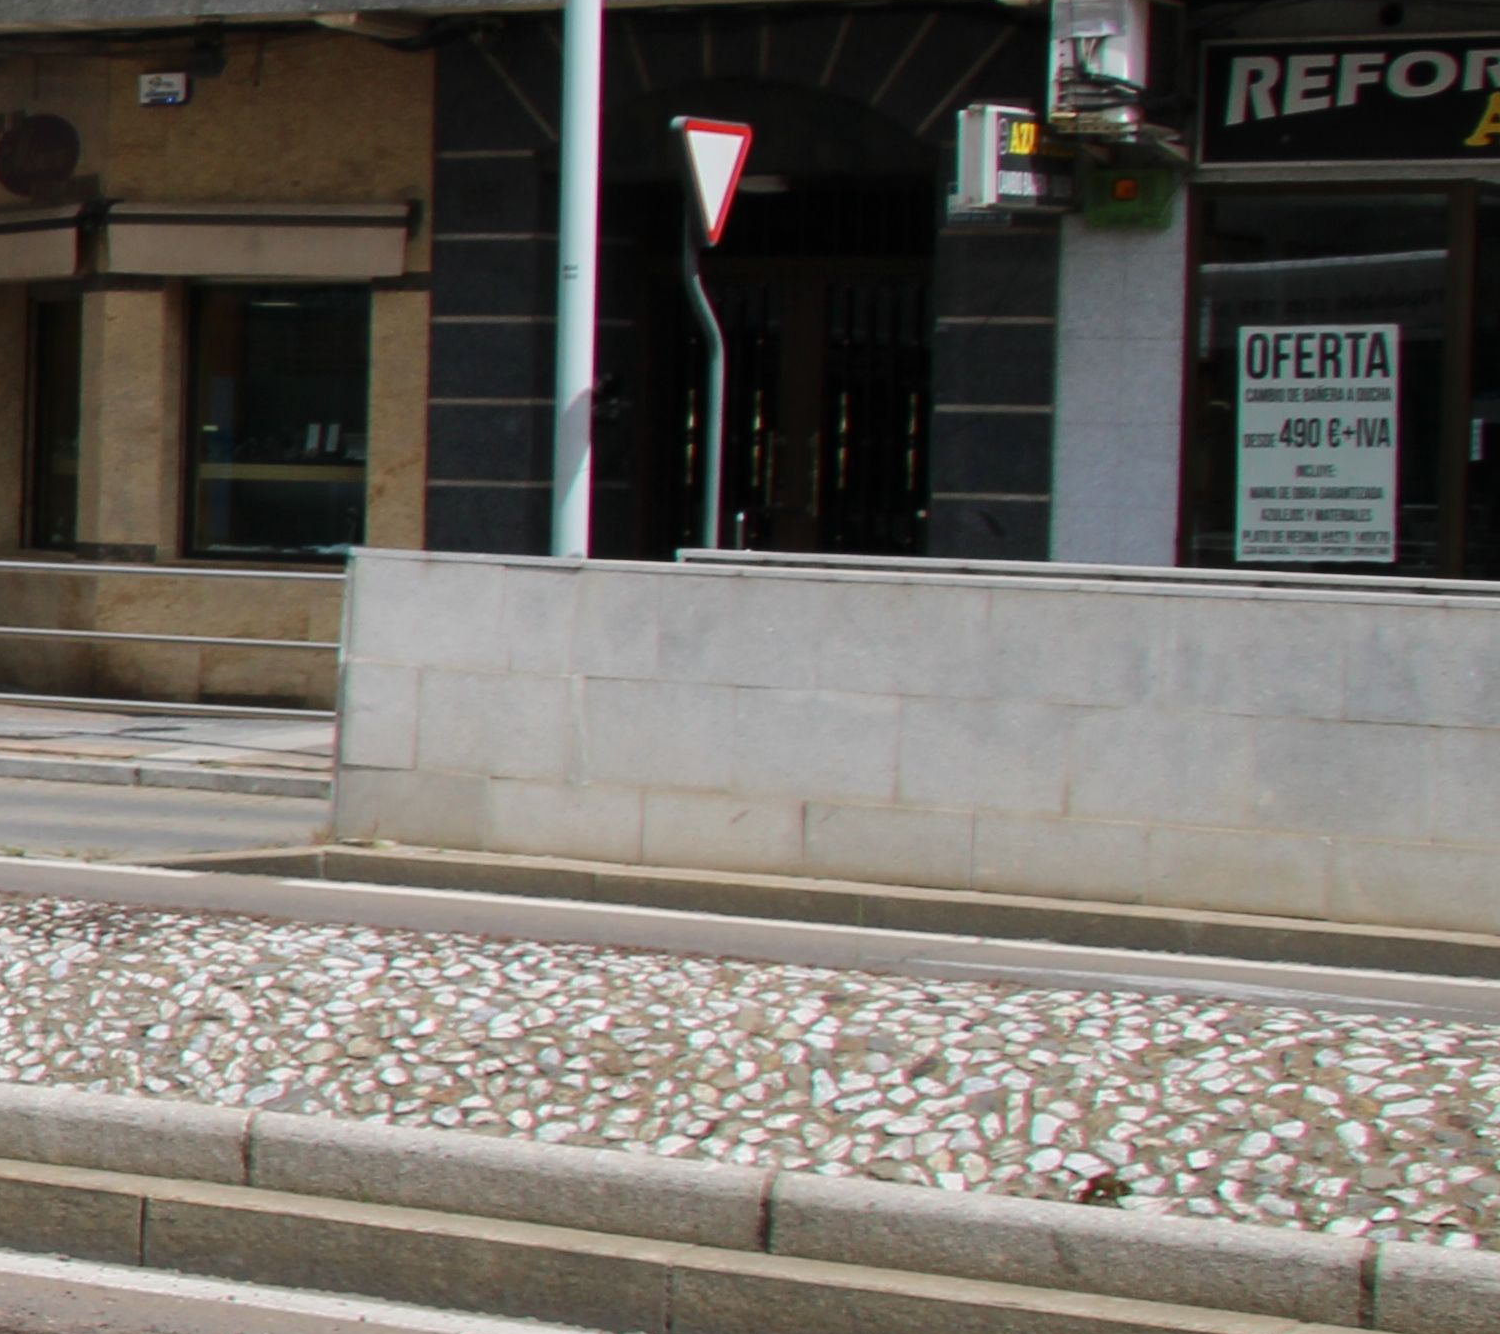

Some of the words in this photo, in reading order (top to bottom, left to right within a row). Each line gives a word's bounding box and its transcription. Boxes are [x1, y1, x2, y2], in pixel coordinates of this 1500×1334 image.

[1245, 330, 1391, 380] OFERTA
[1245, 387, 1286, 403] CAMBIO
[1287, 387, 1301, 403] DE
[1279, 417, 1321, 448] 490
